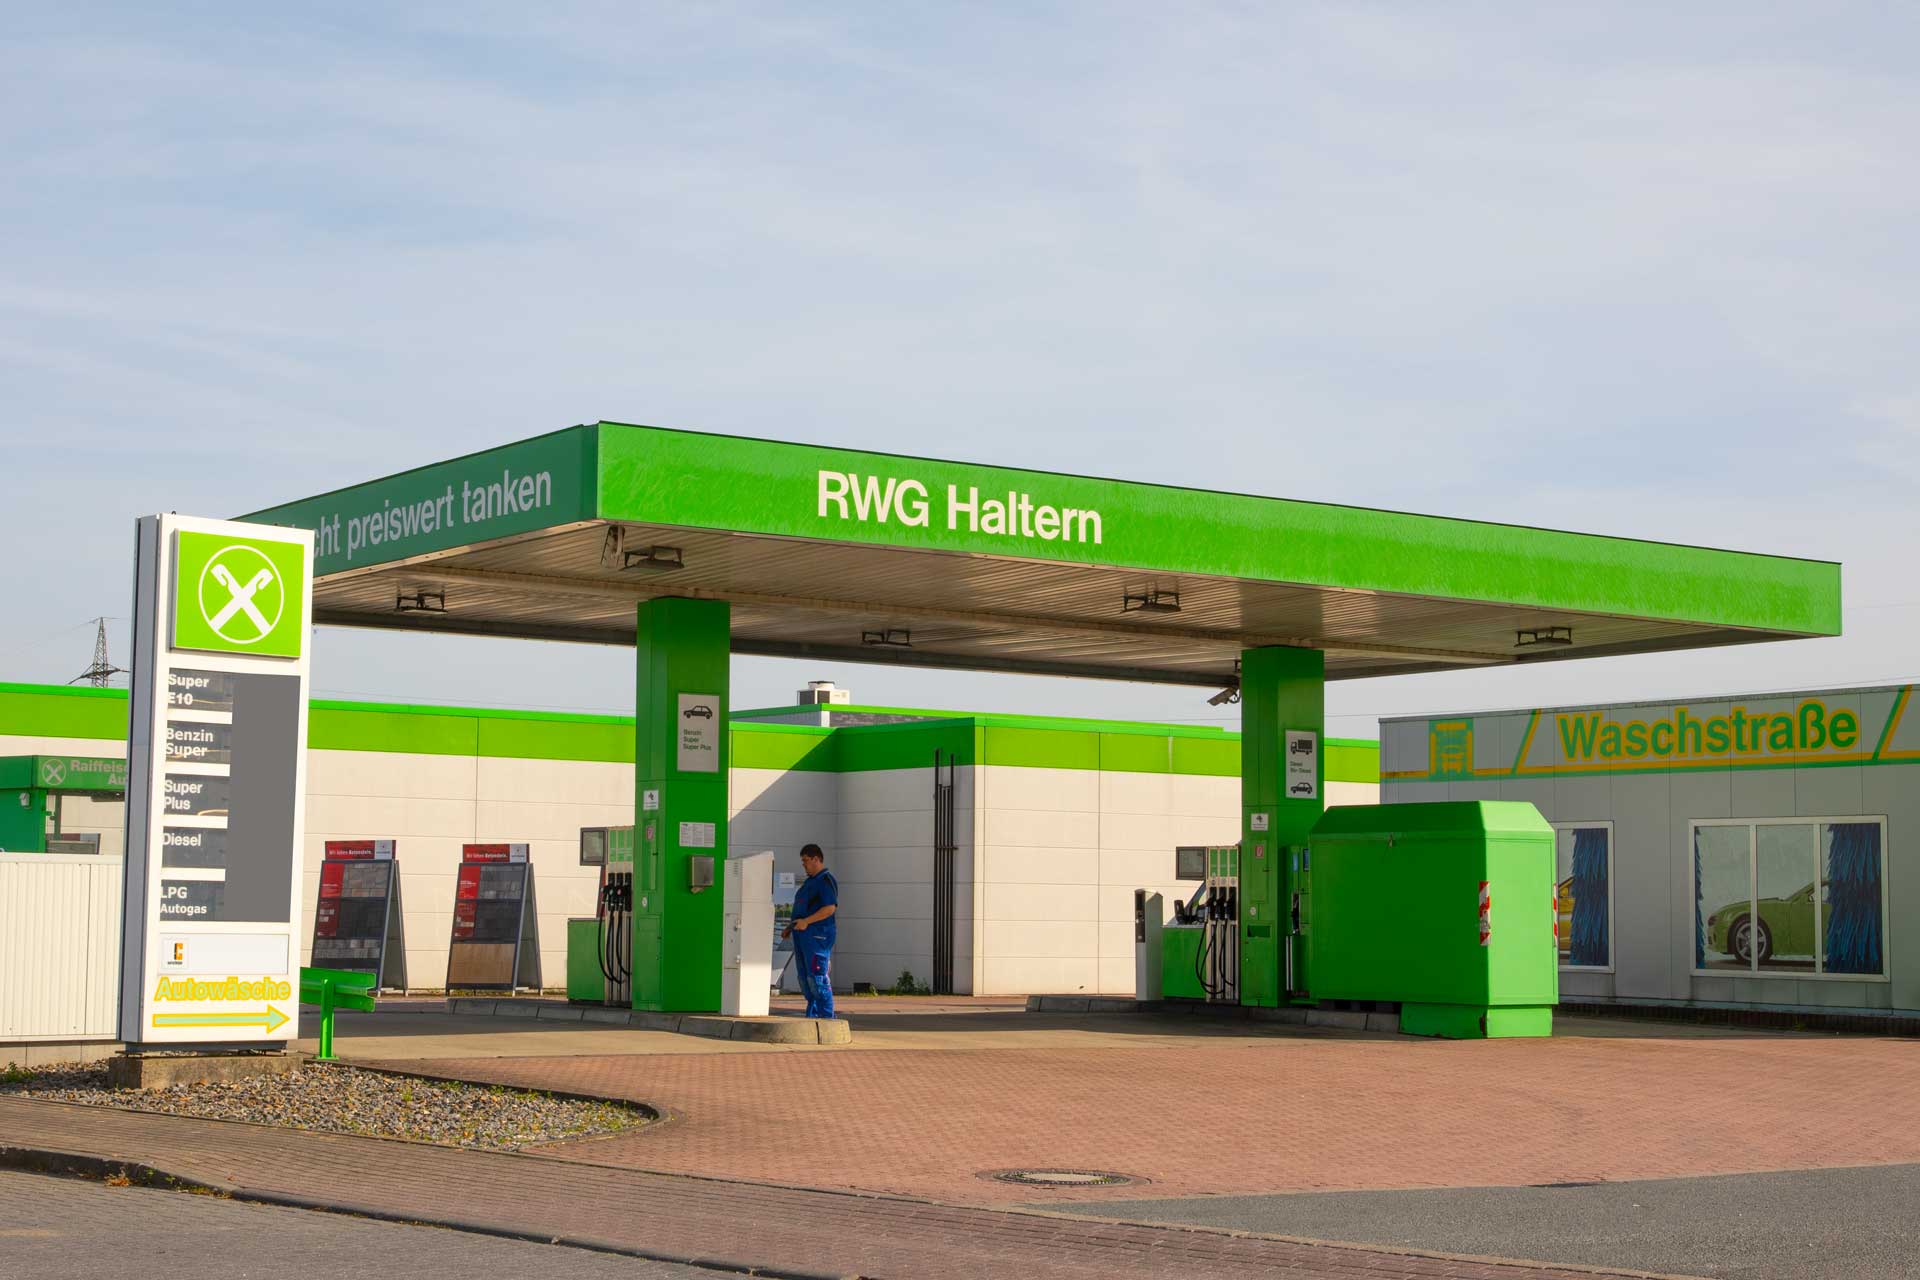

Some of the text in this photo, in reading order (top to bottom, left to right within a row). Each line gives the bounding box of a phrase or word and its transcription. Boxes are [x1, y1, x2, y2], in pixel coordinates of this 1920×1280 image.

[347, 484, 454, 561] preiswert
[462, 469, 552, 524] tanken
[818, 469, 1103, 545] RWG Haltern
[168, 673, 210, 690] Super
[167, 691, 194, 706] E10
[166, 727, 214, 743] Benzin
[1556, 698, 1861, 763] Waschstraße
[165, 742, 209, 759] Super
[70, 759, 127, 773] Raiffeis
[163, 779, 203, 796] Super
[162, 796, 192, 810] Plus
[161, 832, 202, 847] Diesel
[160, 886, 188, 899] LPG
[160, 903, 208, 917] Autogas
[154, 975, 292, 1002] Autowäsche
